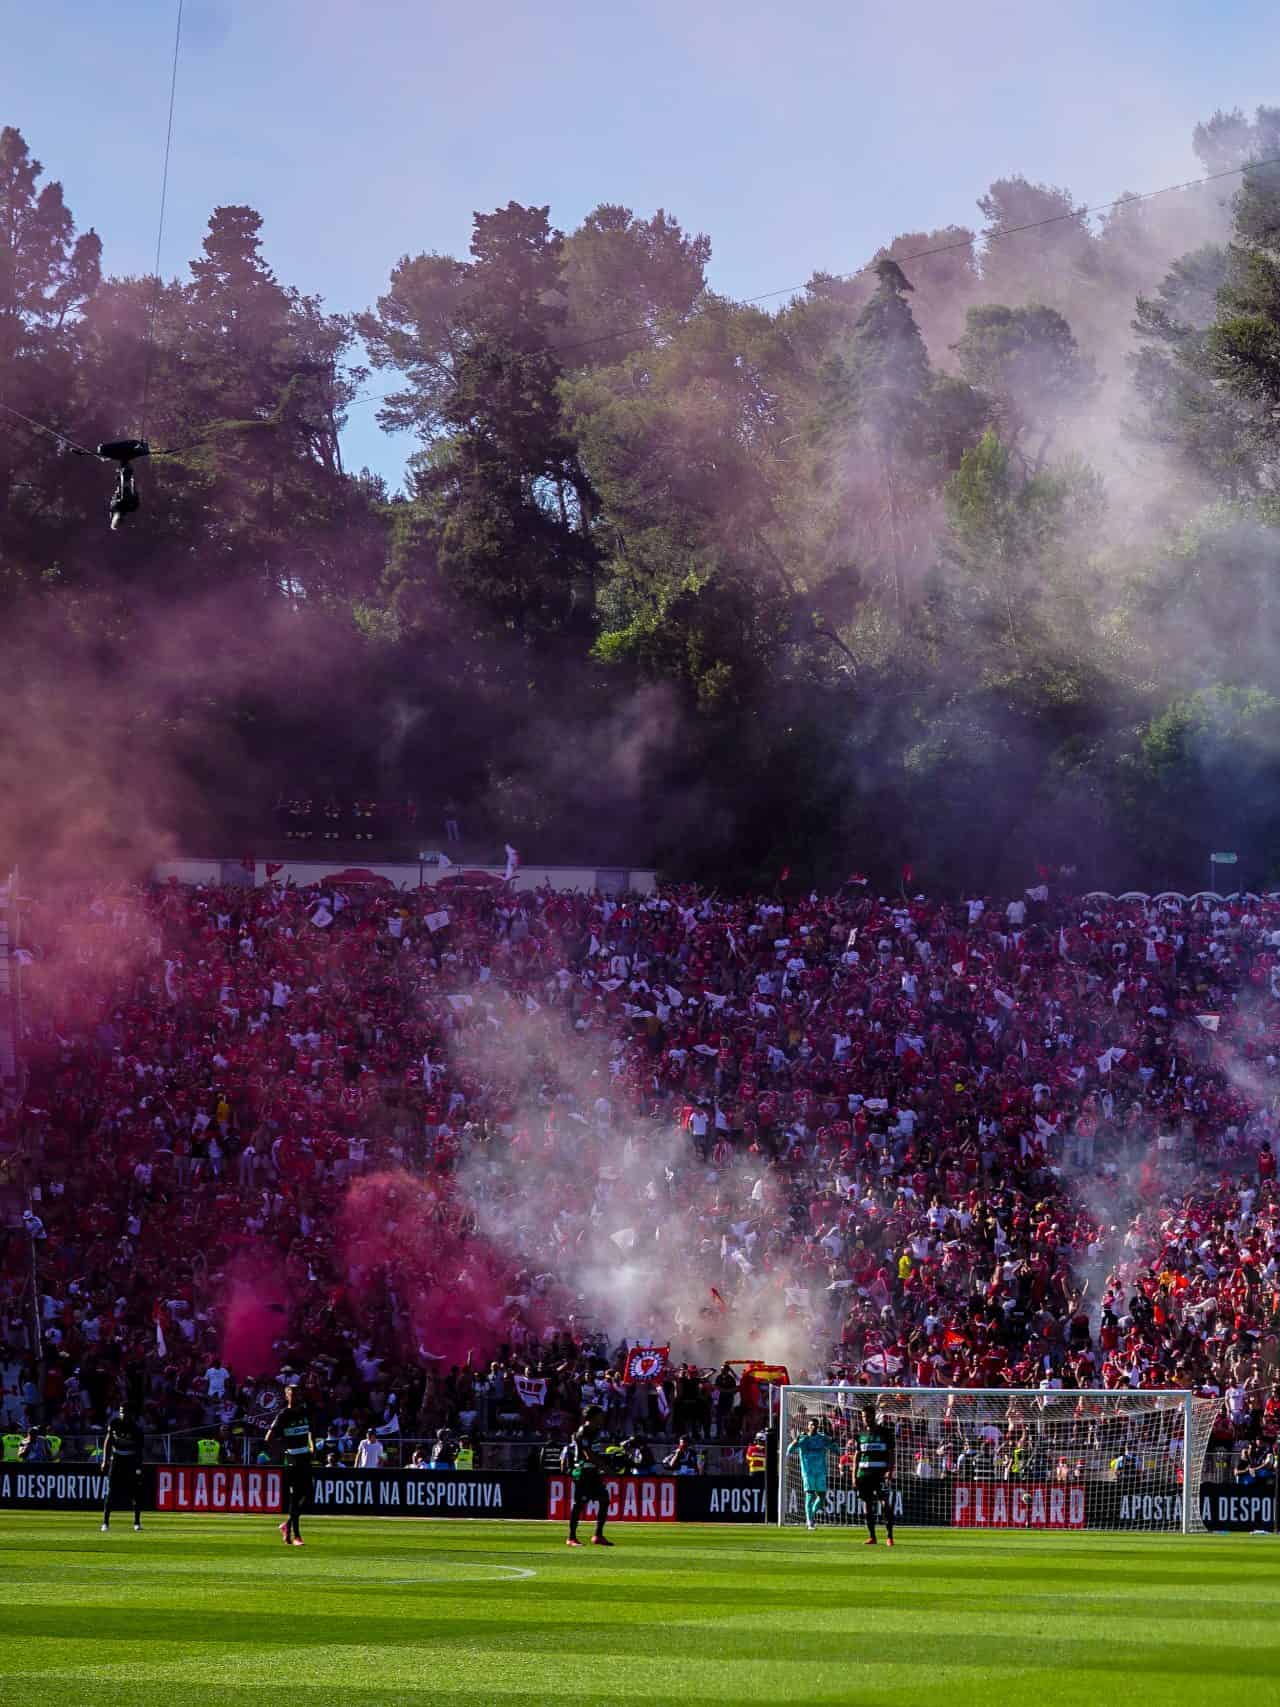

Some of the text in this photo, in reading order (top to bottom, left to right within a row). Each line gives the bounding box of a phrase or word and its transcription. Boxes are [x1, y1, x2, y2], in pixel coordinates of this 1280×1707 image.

[16, 1474, 111, 1499] DESPORTIVA
[159, 1472, 281, 1507] PLACARD
[314, 1480, 502, 1507] APOSTA NA DESPORTIVA
[955, 1488, 1084, 1523] PLACARD
[1120, 1495, 1182, 1521] APOSTA
